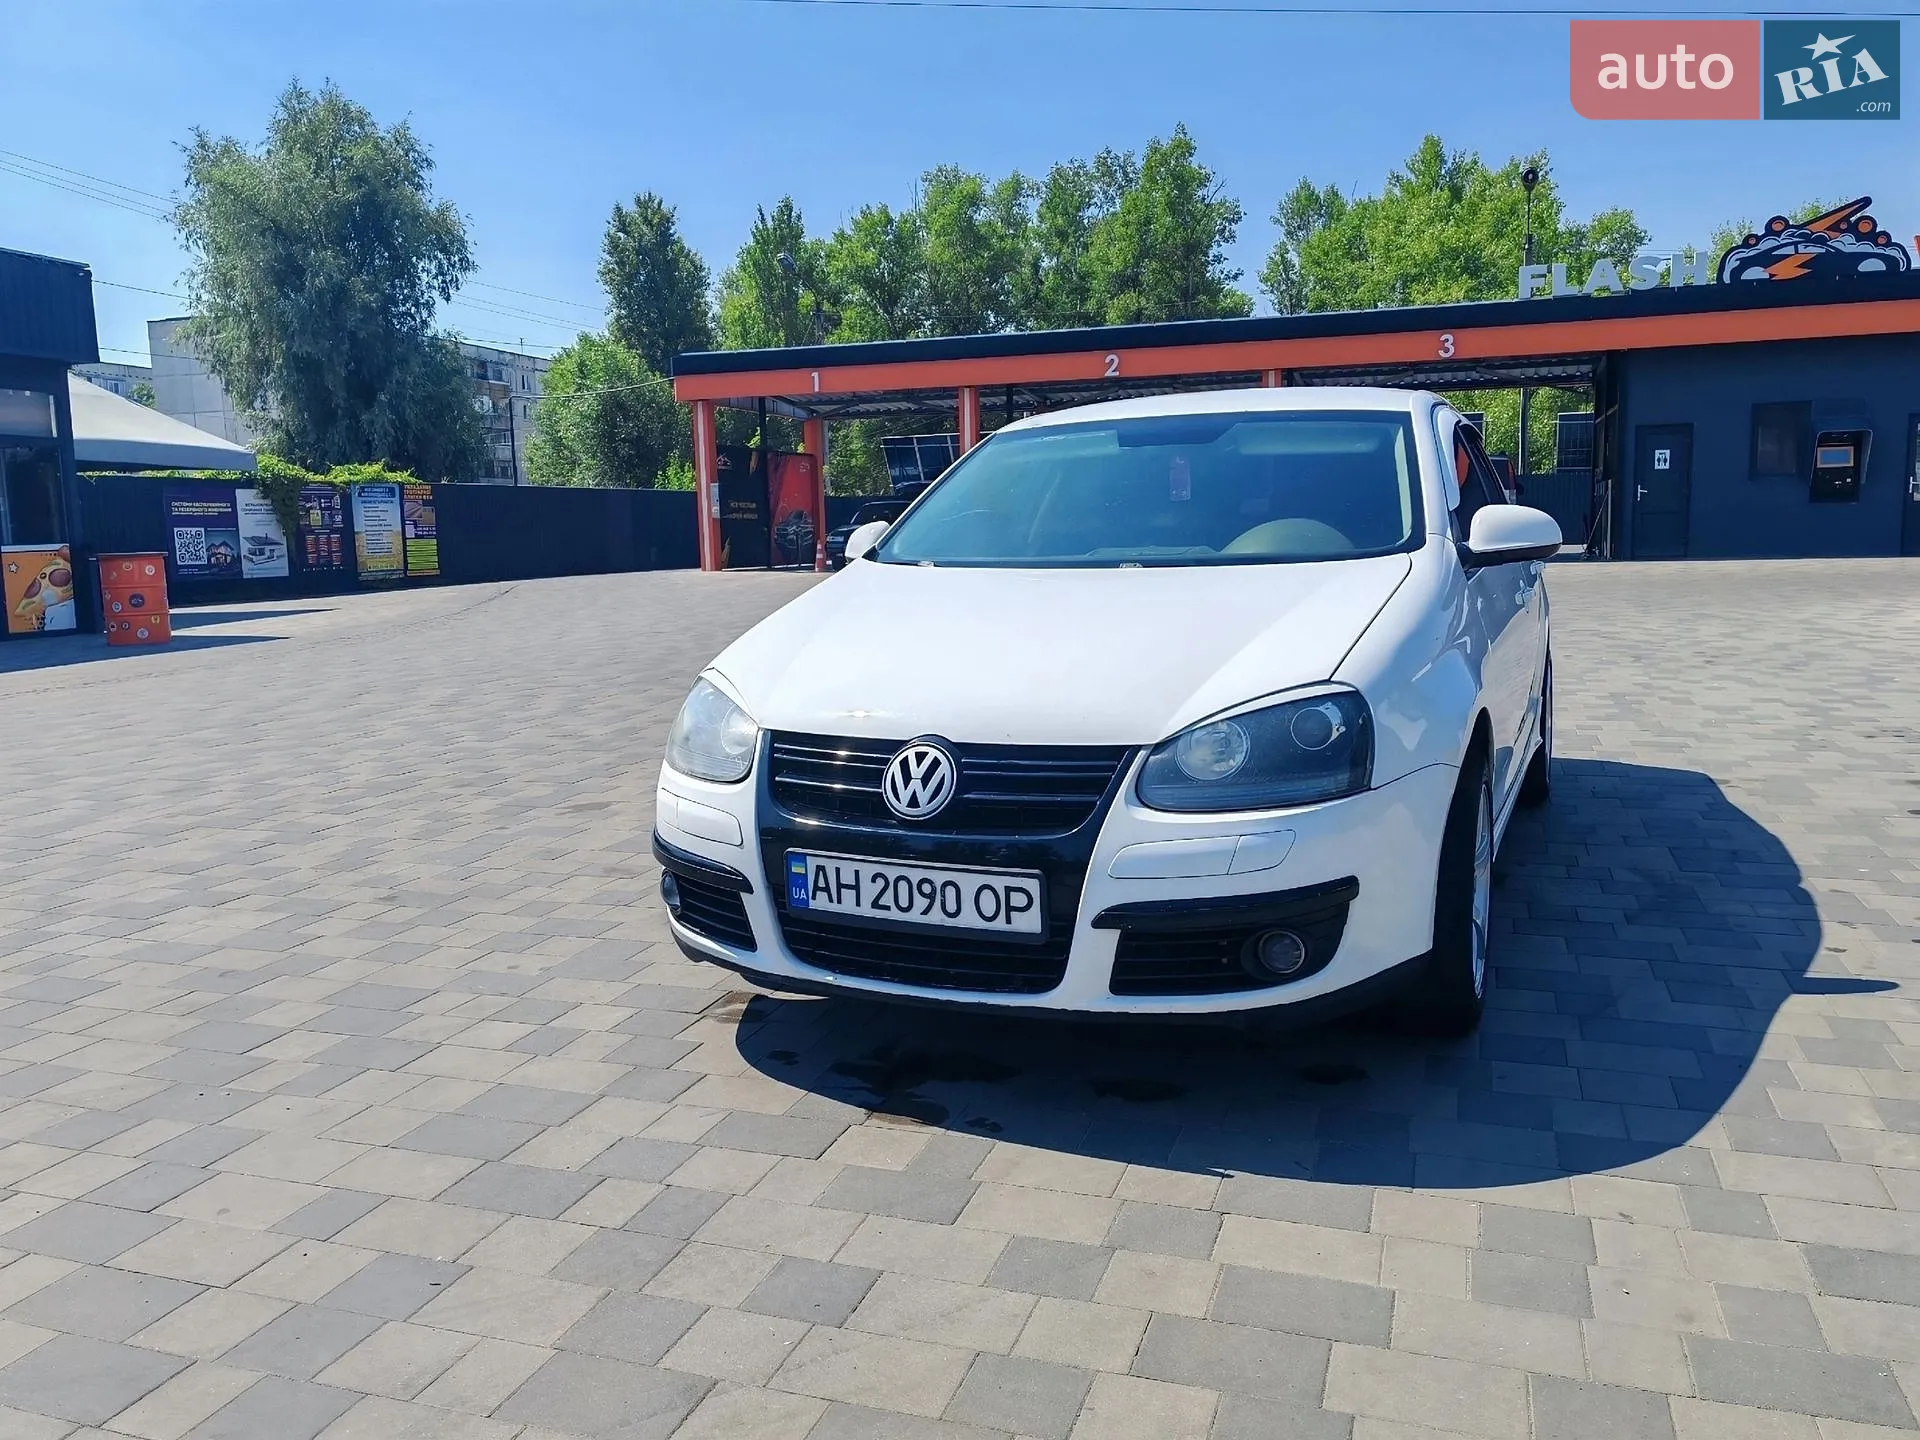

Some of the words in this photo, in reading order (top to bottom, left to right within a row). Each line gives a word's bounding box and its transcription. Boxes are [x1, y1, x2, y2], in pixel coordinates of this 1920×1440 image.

[1519, 250, 1709, 300] FLASH
[1438, 333, 1455, 358] 3
[1104, 354, 1120, 377] 2
[811, 371, 820, 392] 1
[792, 886, 807, 900] UA
[811, 864, 861, 907] AH
[870, 871, 962, 919] 2090
[973, 883, 1034, 925] OP
